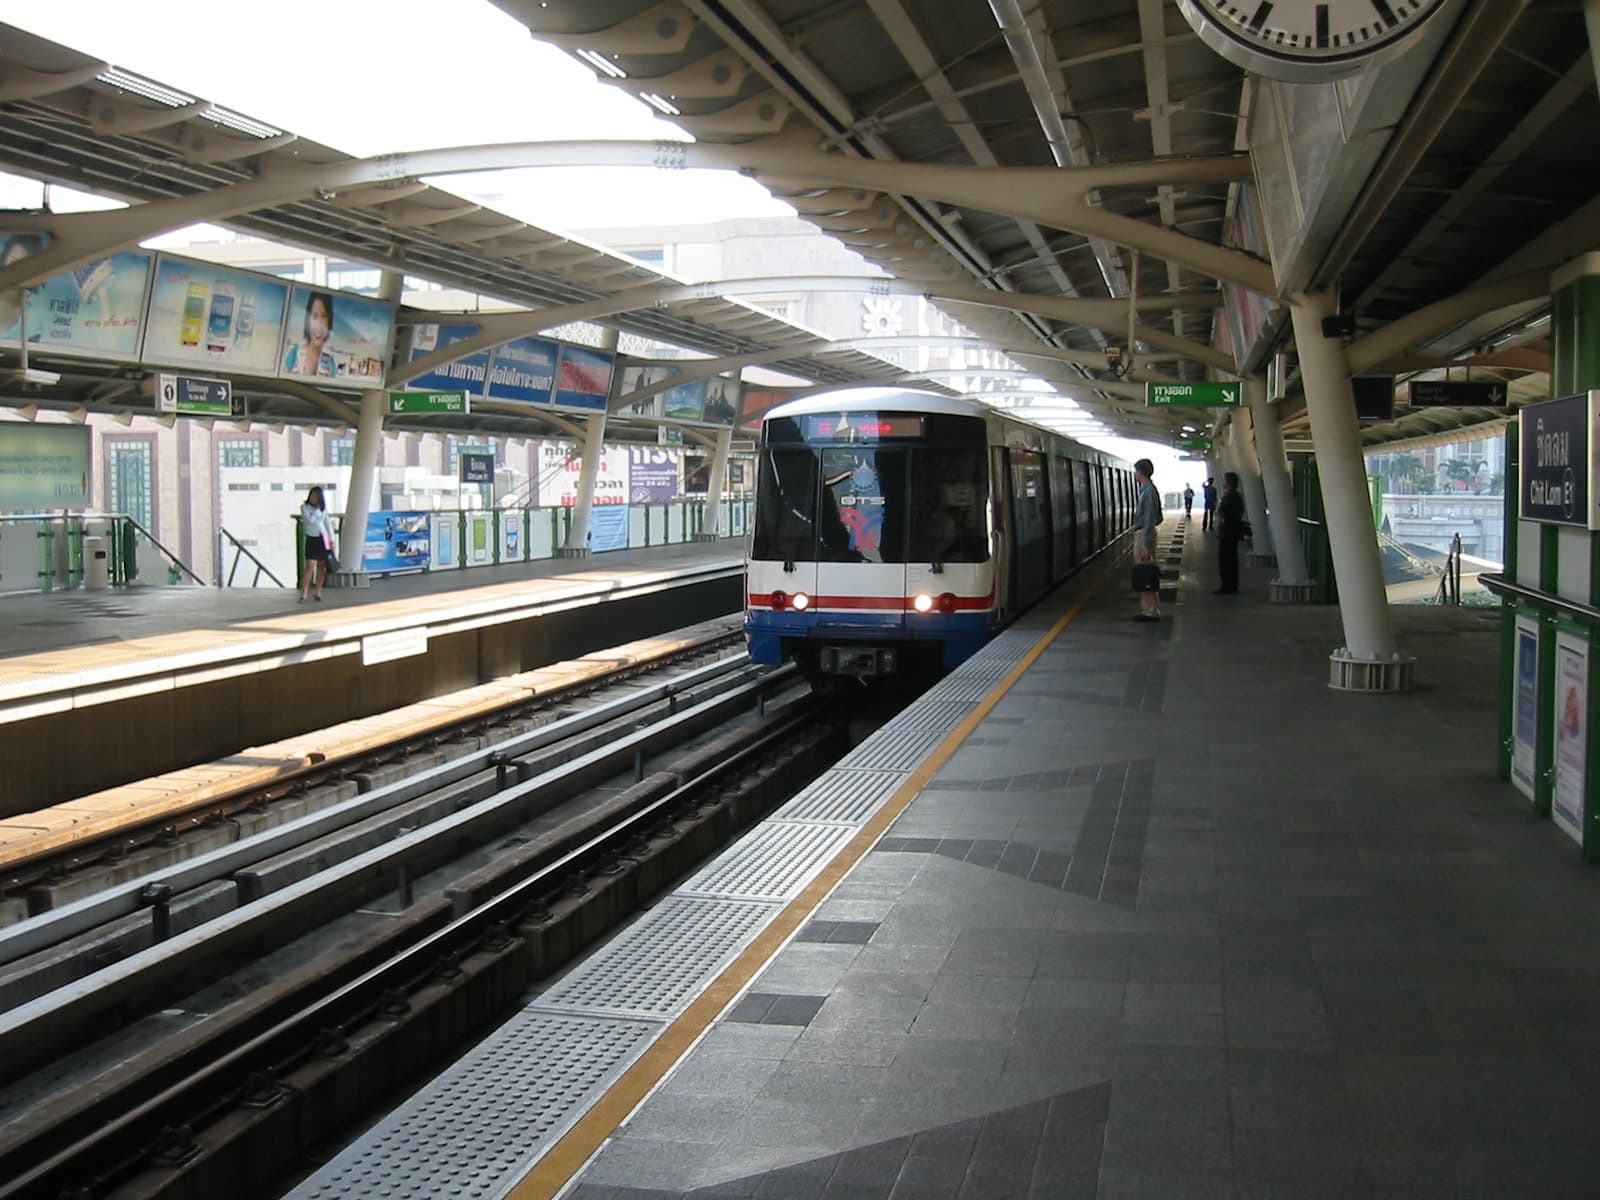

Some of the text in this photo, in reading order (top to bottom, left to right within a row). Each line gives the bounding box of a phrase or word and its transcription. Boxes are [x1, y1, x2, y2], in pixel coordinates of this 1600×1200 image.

[1154, 386, 1192, 396] ทางออก
[1536, 417, 1569, 467] ชิดลม
[1530, 479, 1544, 505] Chit
[1545, 480, 1561, 506] Lom
